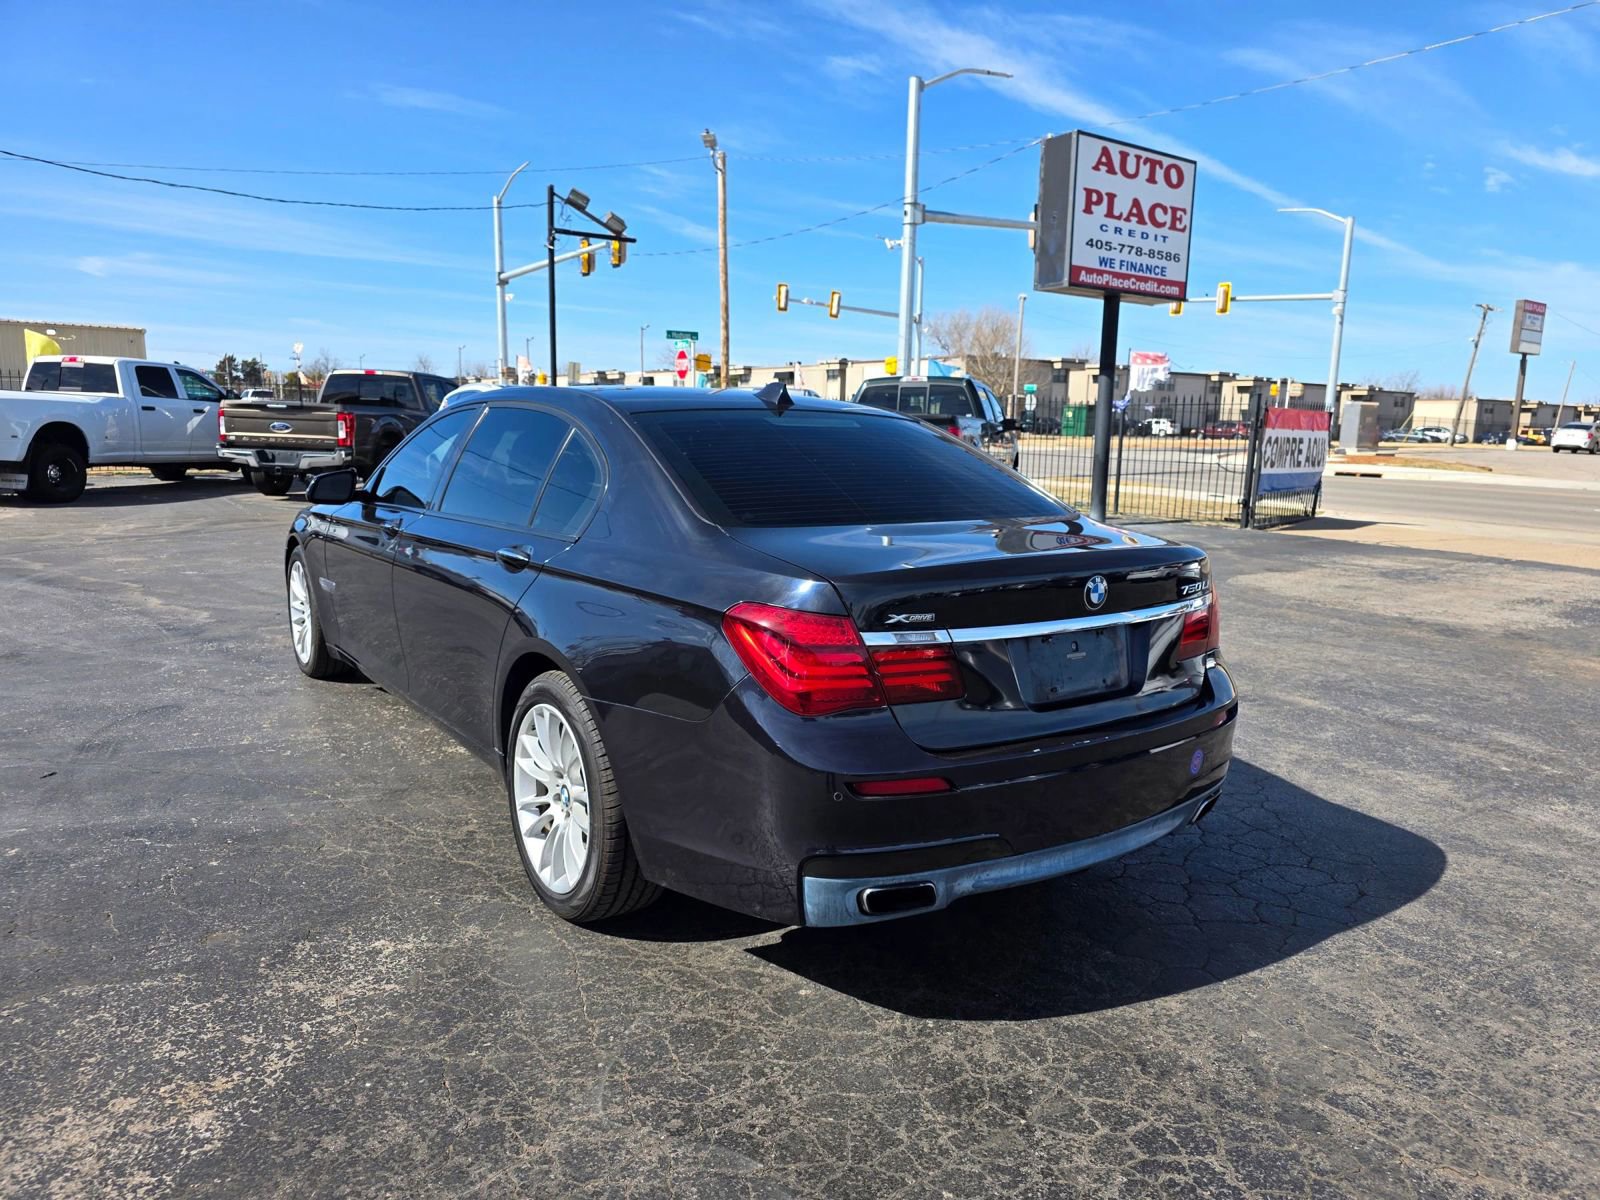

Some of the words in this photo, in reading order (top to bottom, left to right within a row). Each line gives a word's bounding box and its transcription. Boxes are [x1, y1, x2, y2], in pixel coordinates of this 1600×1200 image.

[1092, 145, 1185, 190] AUTO
[1082, 187, 1188, 233] PLACE
[1099, 223, 1169, 244] CREDIT
[1085, 237, 1182, 264] 405-778-8586
[1098, 255, 1116, 270] WE
[1119, 259, 1168, 277] FINANCE
[1079, 270, 1180, 296] AutoPlaceCredit.com
[1263, 436, 1304, 469] COMPRE
